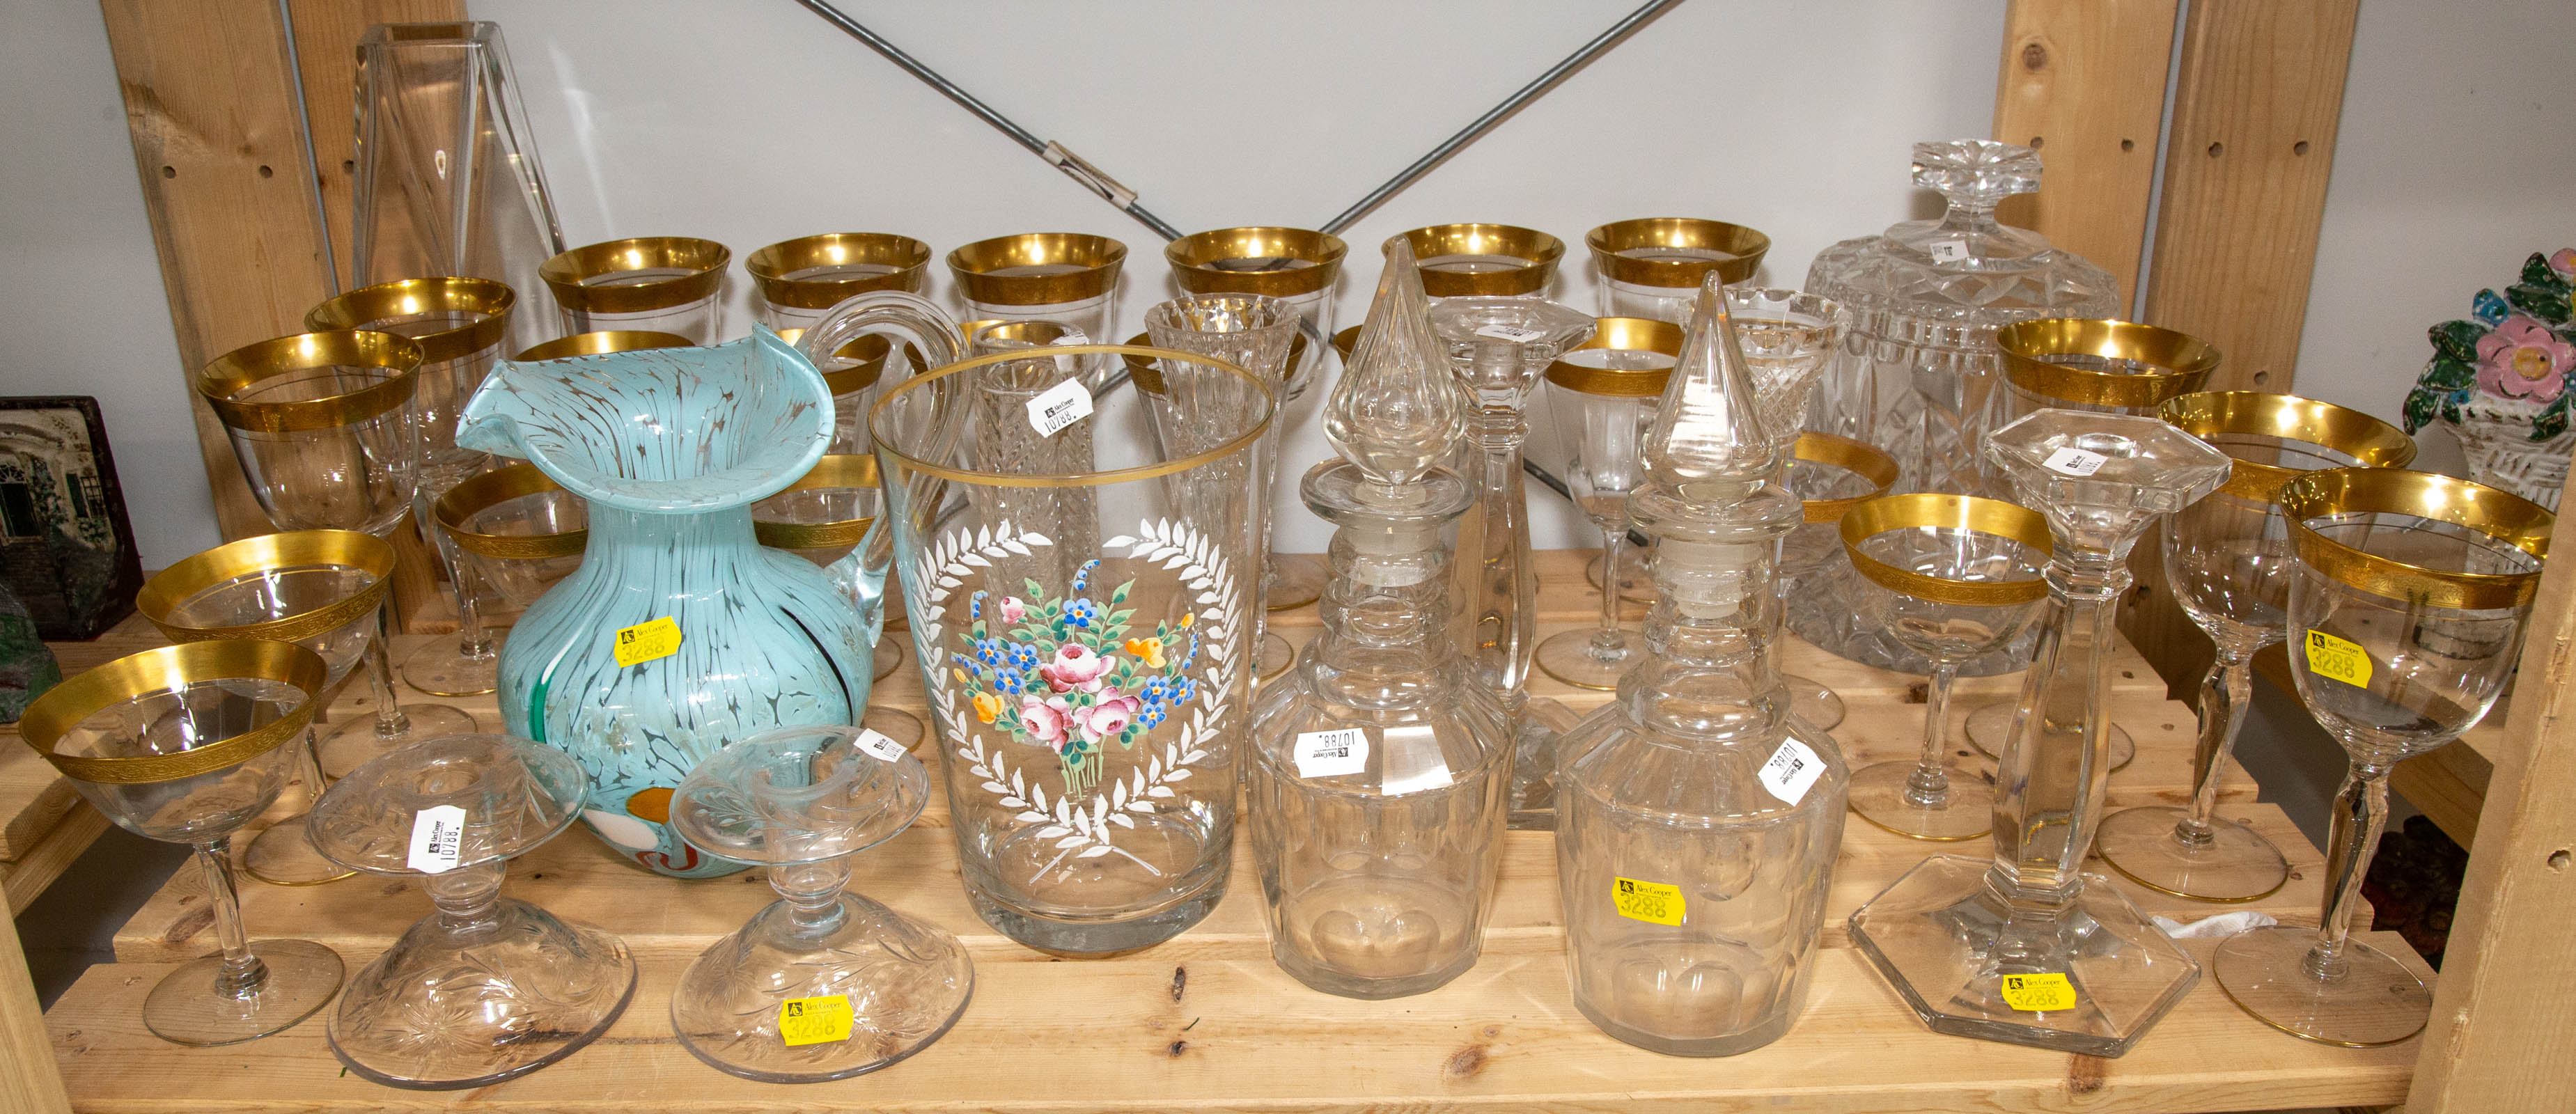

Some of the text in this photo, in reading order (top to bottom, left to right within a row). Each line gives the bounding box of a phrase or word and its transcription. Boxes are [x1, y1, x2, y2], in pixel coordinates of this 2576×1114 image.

[1061, 398, 1074, 407] Cooper
[1045, 411, 1077, 432] 10788.
[648, 624, 668, 633] Cooper
[622, 636, 665, 661] 3288
[2327, 638, 2339, 648] Alex
[2339, 643, 2359, 655] Cooper
[2313, 648, 2355, 678] 3288
[1319, 731, 1355, 748] 10788.
[1770, 742, 1798, 769] 10788.
[432, 820, 441, 834] Cooper
[440, 826, 460, 860] 10788.
[1637, 884, 1649, 893] Alex
[1650, 886, 1671, 897] Cooper
[1621, 892, 1666, 918] 3288
[2038, 978, 2060, 987] Cooper
[819, 1001, 841, 1010] Cooper
[2011, 989, 2059, 1007] 3288
[788, 1014, 836, 1039] 3288
